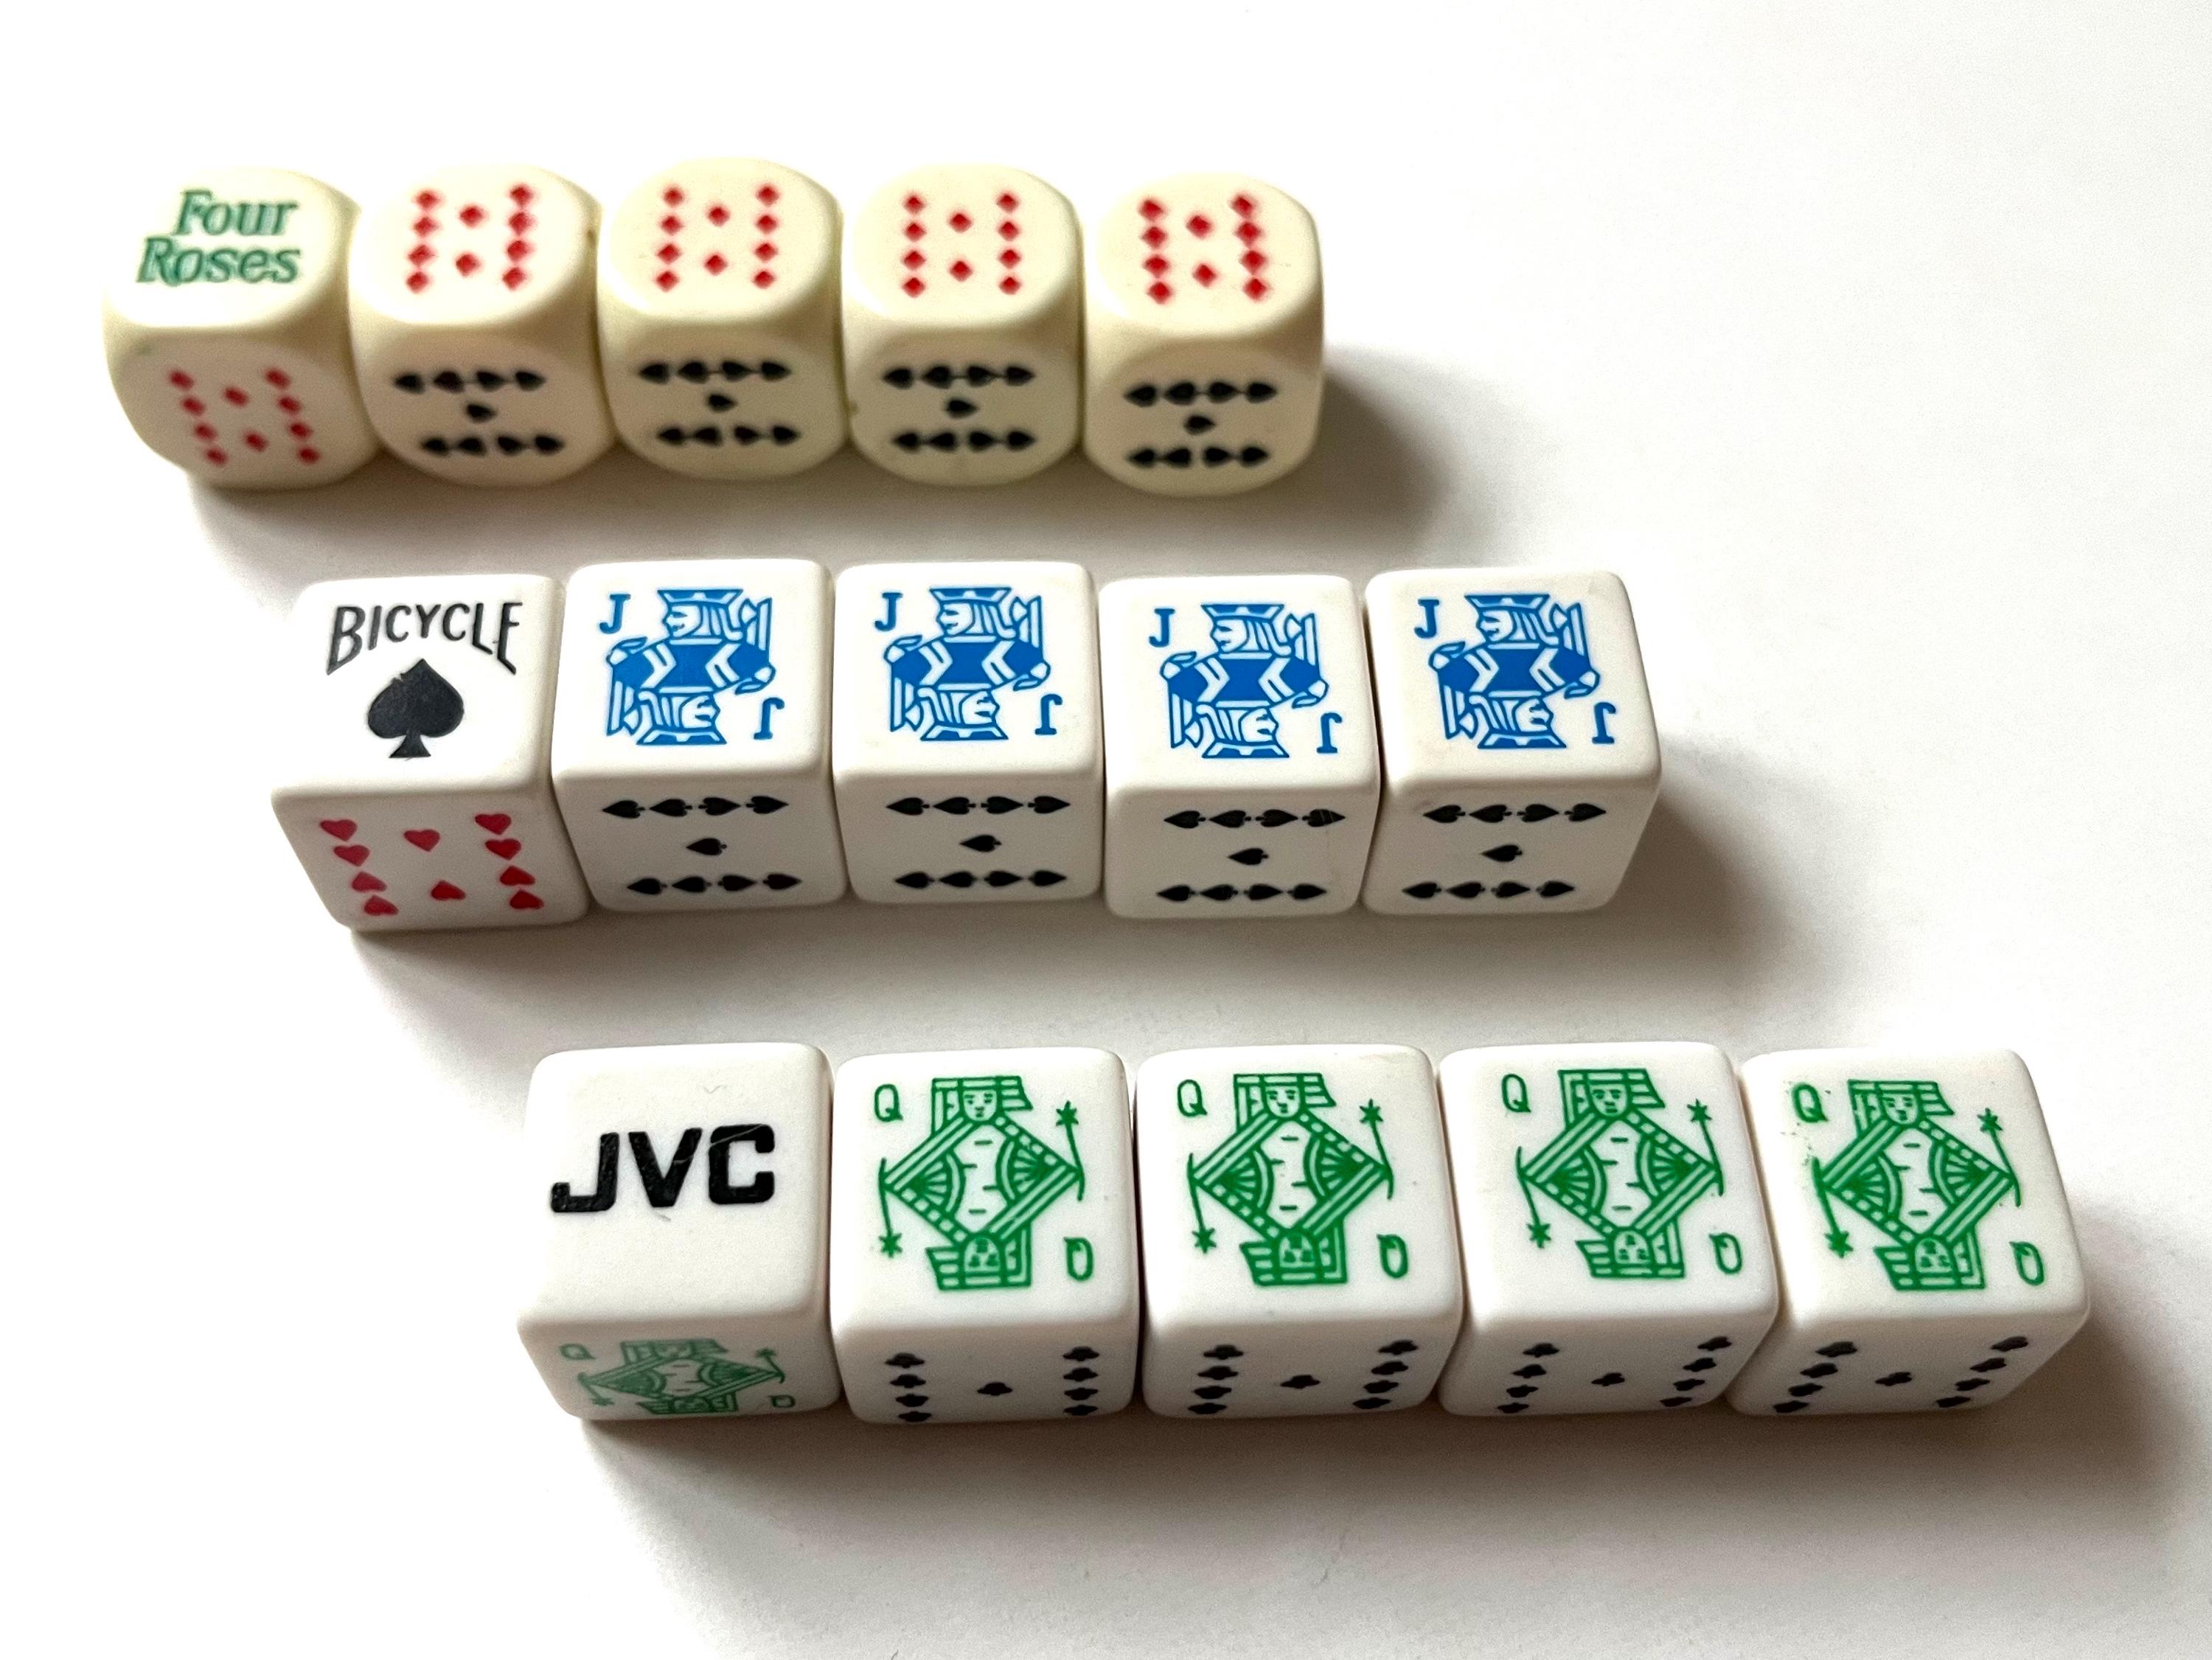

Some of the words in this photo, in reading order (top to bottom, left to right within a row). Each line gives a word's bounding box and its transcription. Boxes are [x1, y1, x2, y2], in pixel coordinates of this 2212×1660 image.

[172, 188, 299, 236] Four
[136, 236, 301, 286] Roses
[598, 592, 631, 635] J
[874, 591, 904, 633] J
[1148, 606, 1176, 648] J
[1414, 598, 1441, 639] J
[326, 600, 523, 676] BICYCLE
[753, 695, 786, 742] J
[1034, 692, 1063, 737] J
[1315, 710, 1343, 755] J
[1590, 701, 1618, 745] J
[872, 1083, 905, 1124] Q
[1176, 1078, 1209, 1119] Q
[1500, 1072, 1533, 1114] Q
[1792, 1082, 1829, 1125] Q
[549, 1123, 776, 1215] JVC
[1063, 1236, 1095, 1284] Q
[1376, 1233, 1410, 1281] Q
[1708, 1231, 1745, 1277] Q
[2008, 1240, 2047, 1288] Q
